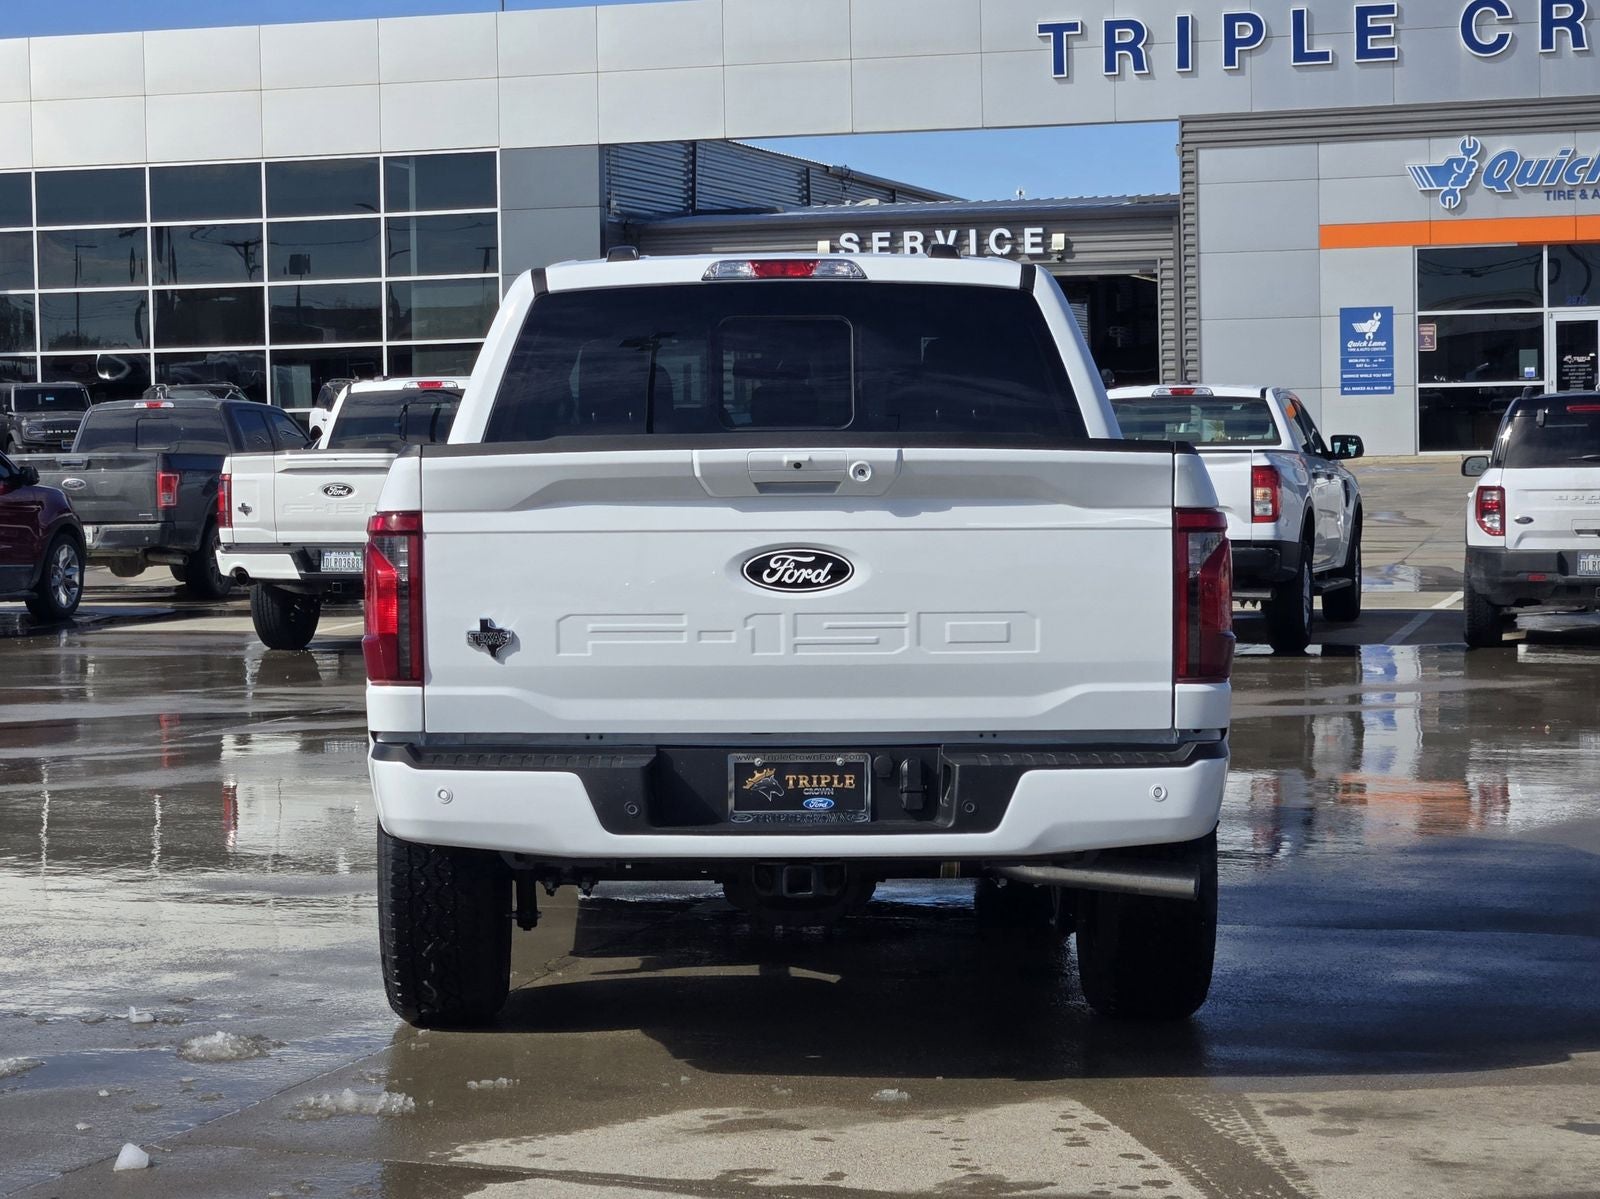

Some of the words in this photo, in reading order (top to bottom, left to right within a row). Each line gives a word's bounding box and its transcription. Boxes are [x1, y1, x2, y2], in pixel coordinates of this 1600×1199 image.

[1036, 2, 1399, 79] TRIPLE
[1459, 0, 1589, 57] CR
[1544, 190, 1576, 201] TIRE
[1579, 190, 1588, 200] &
[838, 227, 1045, 255] SERVICE
[1347, 340, 1367, 348] Quick
[327, 485, 349, 496] Ford
[762, 555, 833, 584] Ford
[468, 631, 510, 645] TEXAS
[556, 611, 1040, 656] F-150
[785, 774, 856, 790] TRIPLE
[803, 787, 835, 796] CROWN
